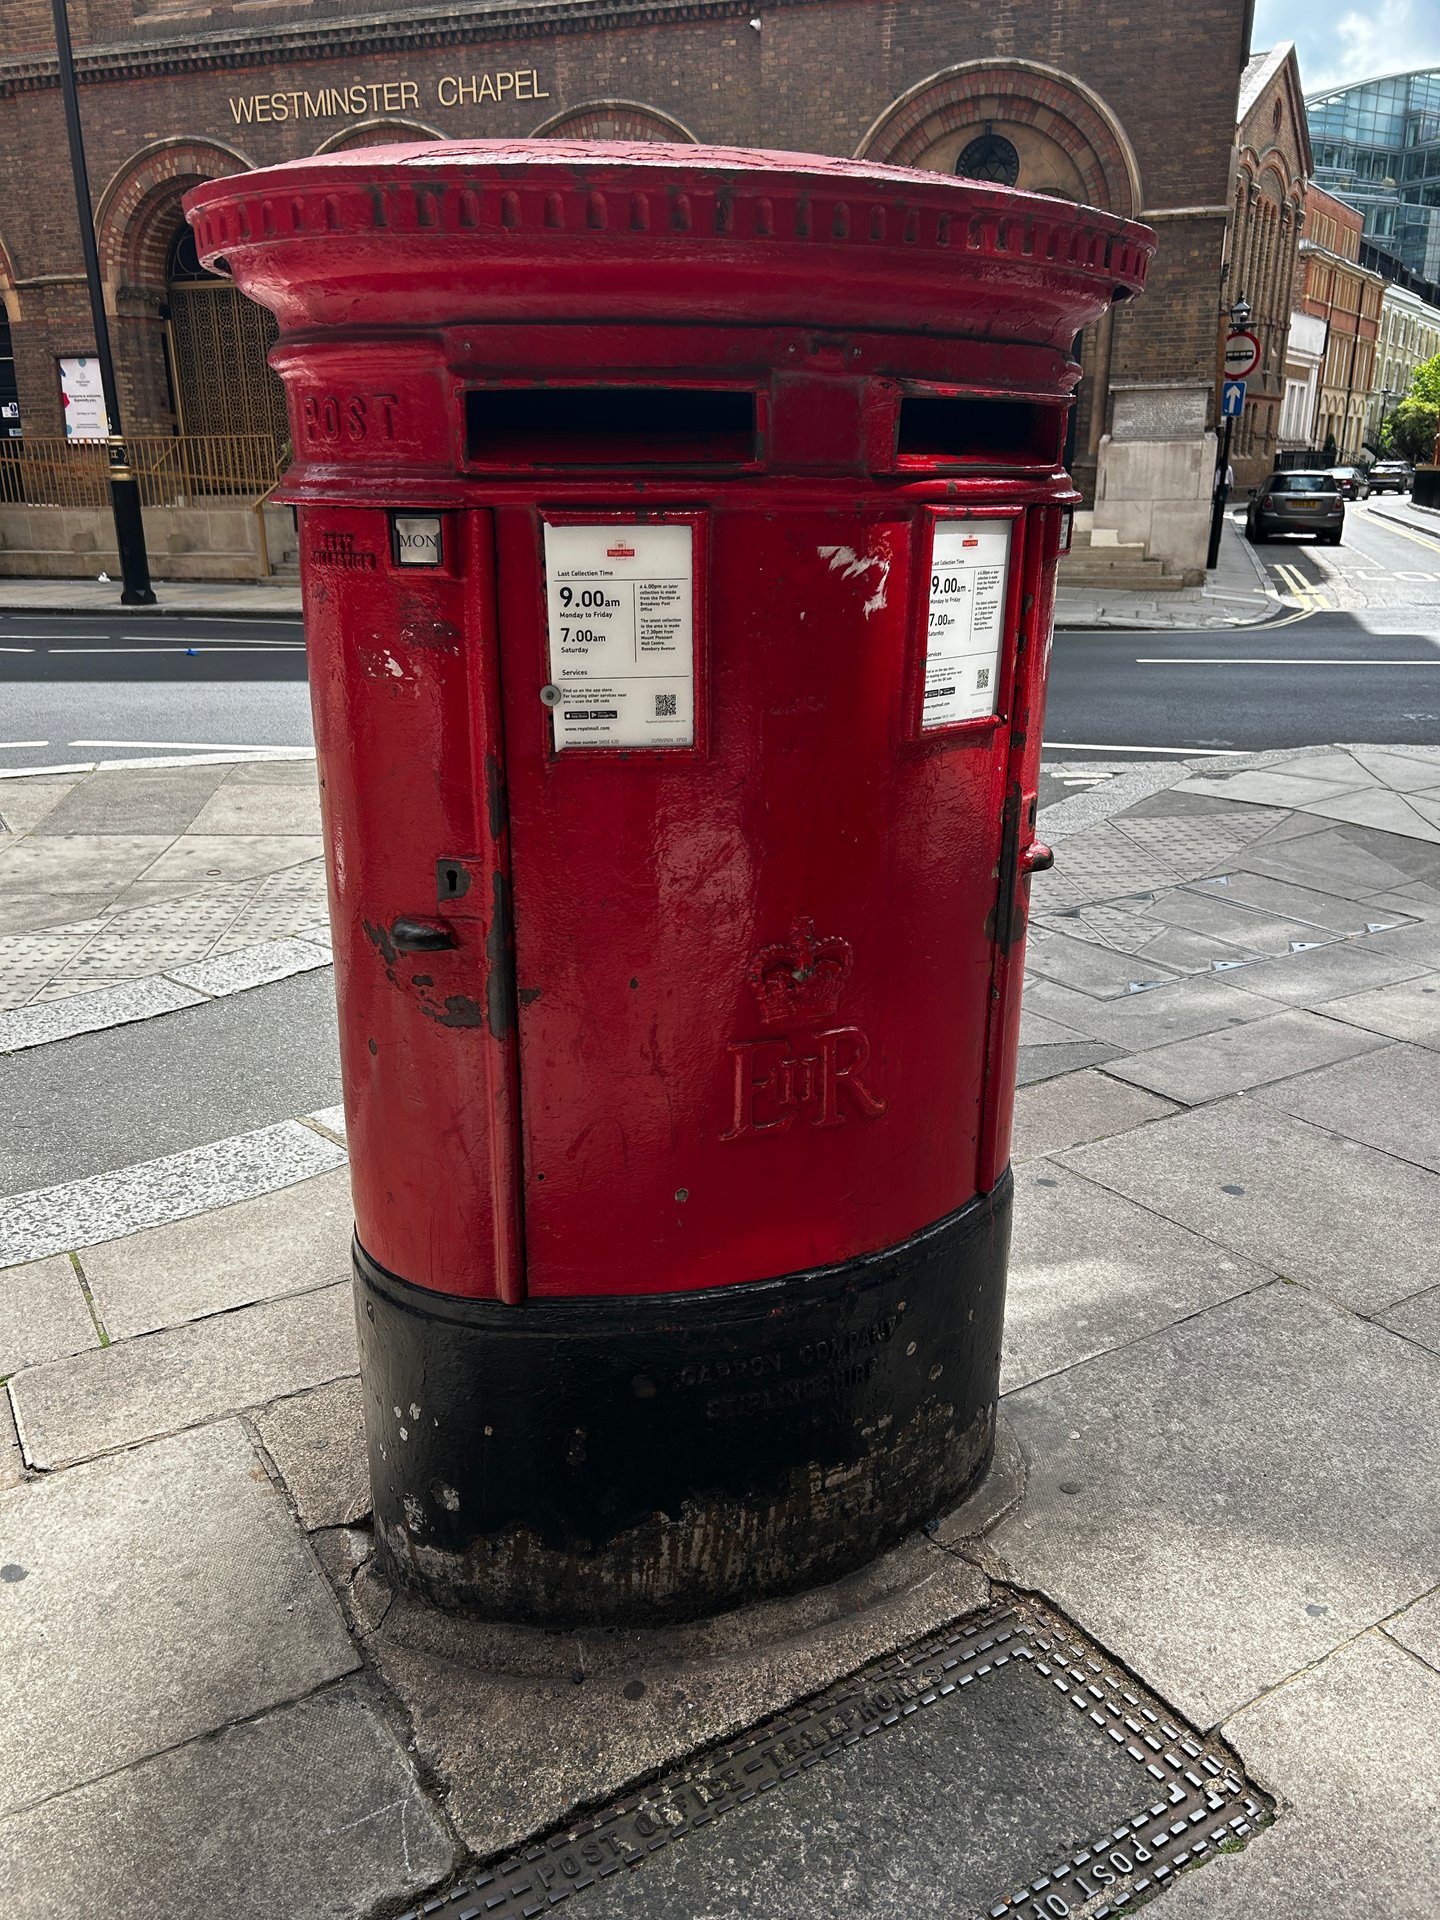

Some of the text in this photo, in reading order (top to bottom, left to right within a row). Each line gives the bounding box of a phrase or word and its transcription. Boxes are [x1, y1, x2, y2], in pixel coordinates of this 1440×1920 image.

[229, 70, 549, 124] WESTMINSTER CHAPEL
[304, 394, 398, 443] POST
[400, 535, 437, 548] MON
[932, 575, 966, 595] 9.00am
[560, 586, 620, 608] 9.00am
[593, 611, 613, 619] Friday
[929, 613, 955, 627] 7.00am
[560, 628, 606, 642] 7.00am
[537, 1830, 620, 1888] POST
[1015, 1839, 1152, 1920] POST OF
